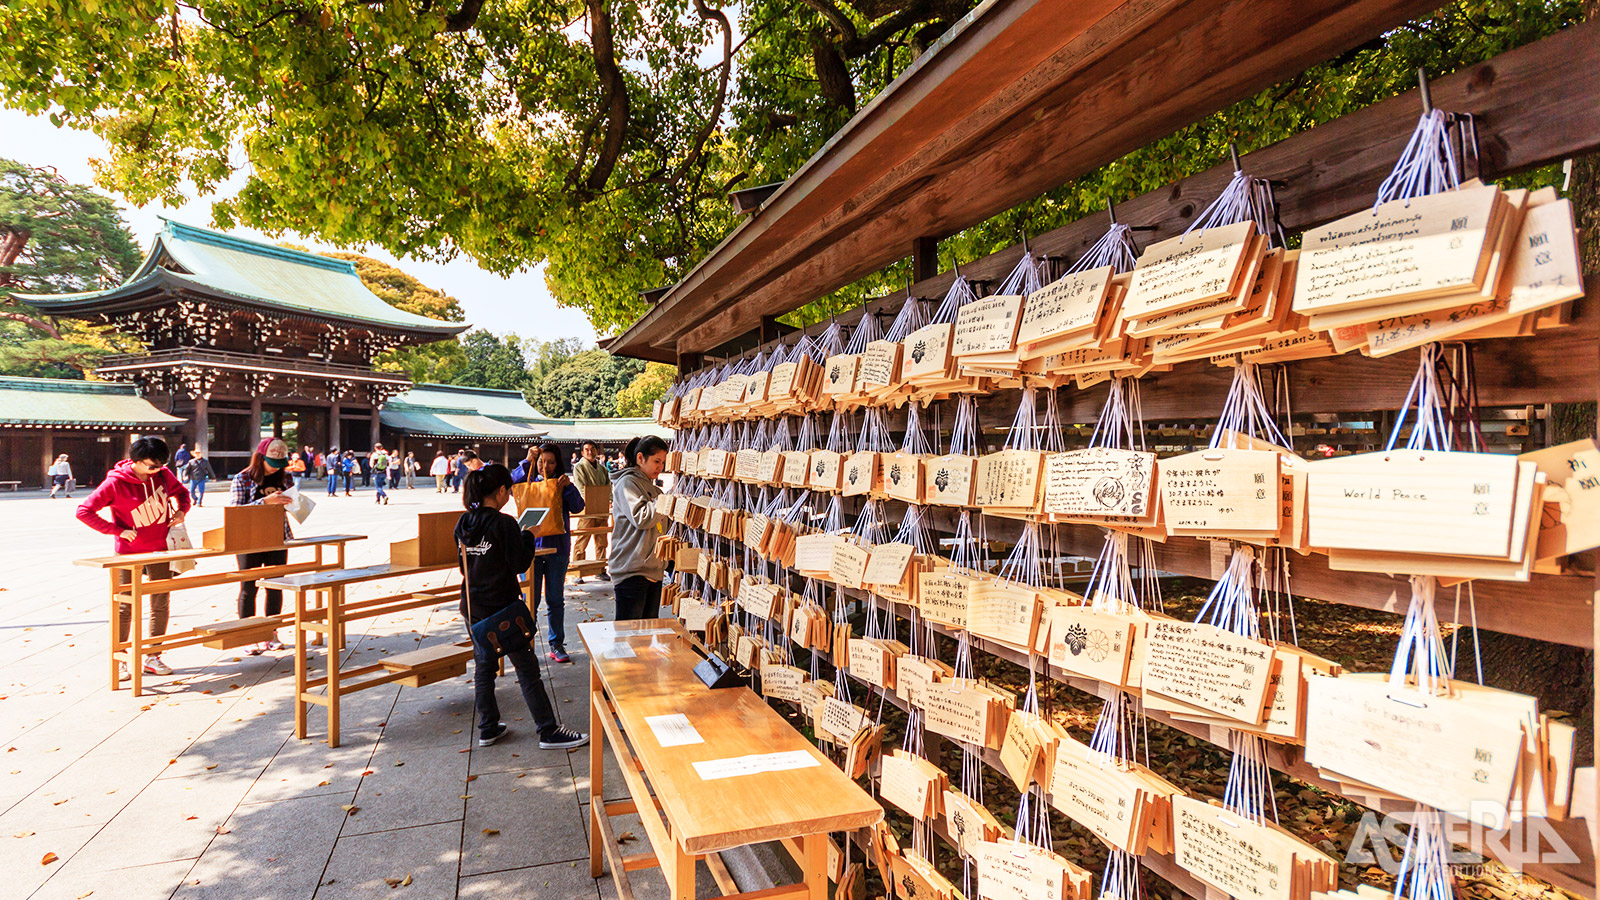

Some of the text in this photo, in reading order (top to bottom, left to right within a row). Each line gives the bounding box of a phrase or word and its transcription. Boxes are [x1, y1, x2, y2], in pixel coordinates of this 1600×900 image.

[1344, 489, 1427, 501] World Peace
[1179, 658, 1209, 670] FOREVER
